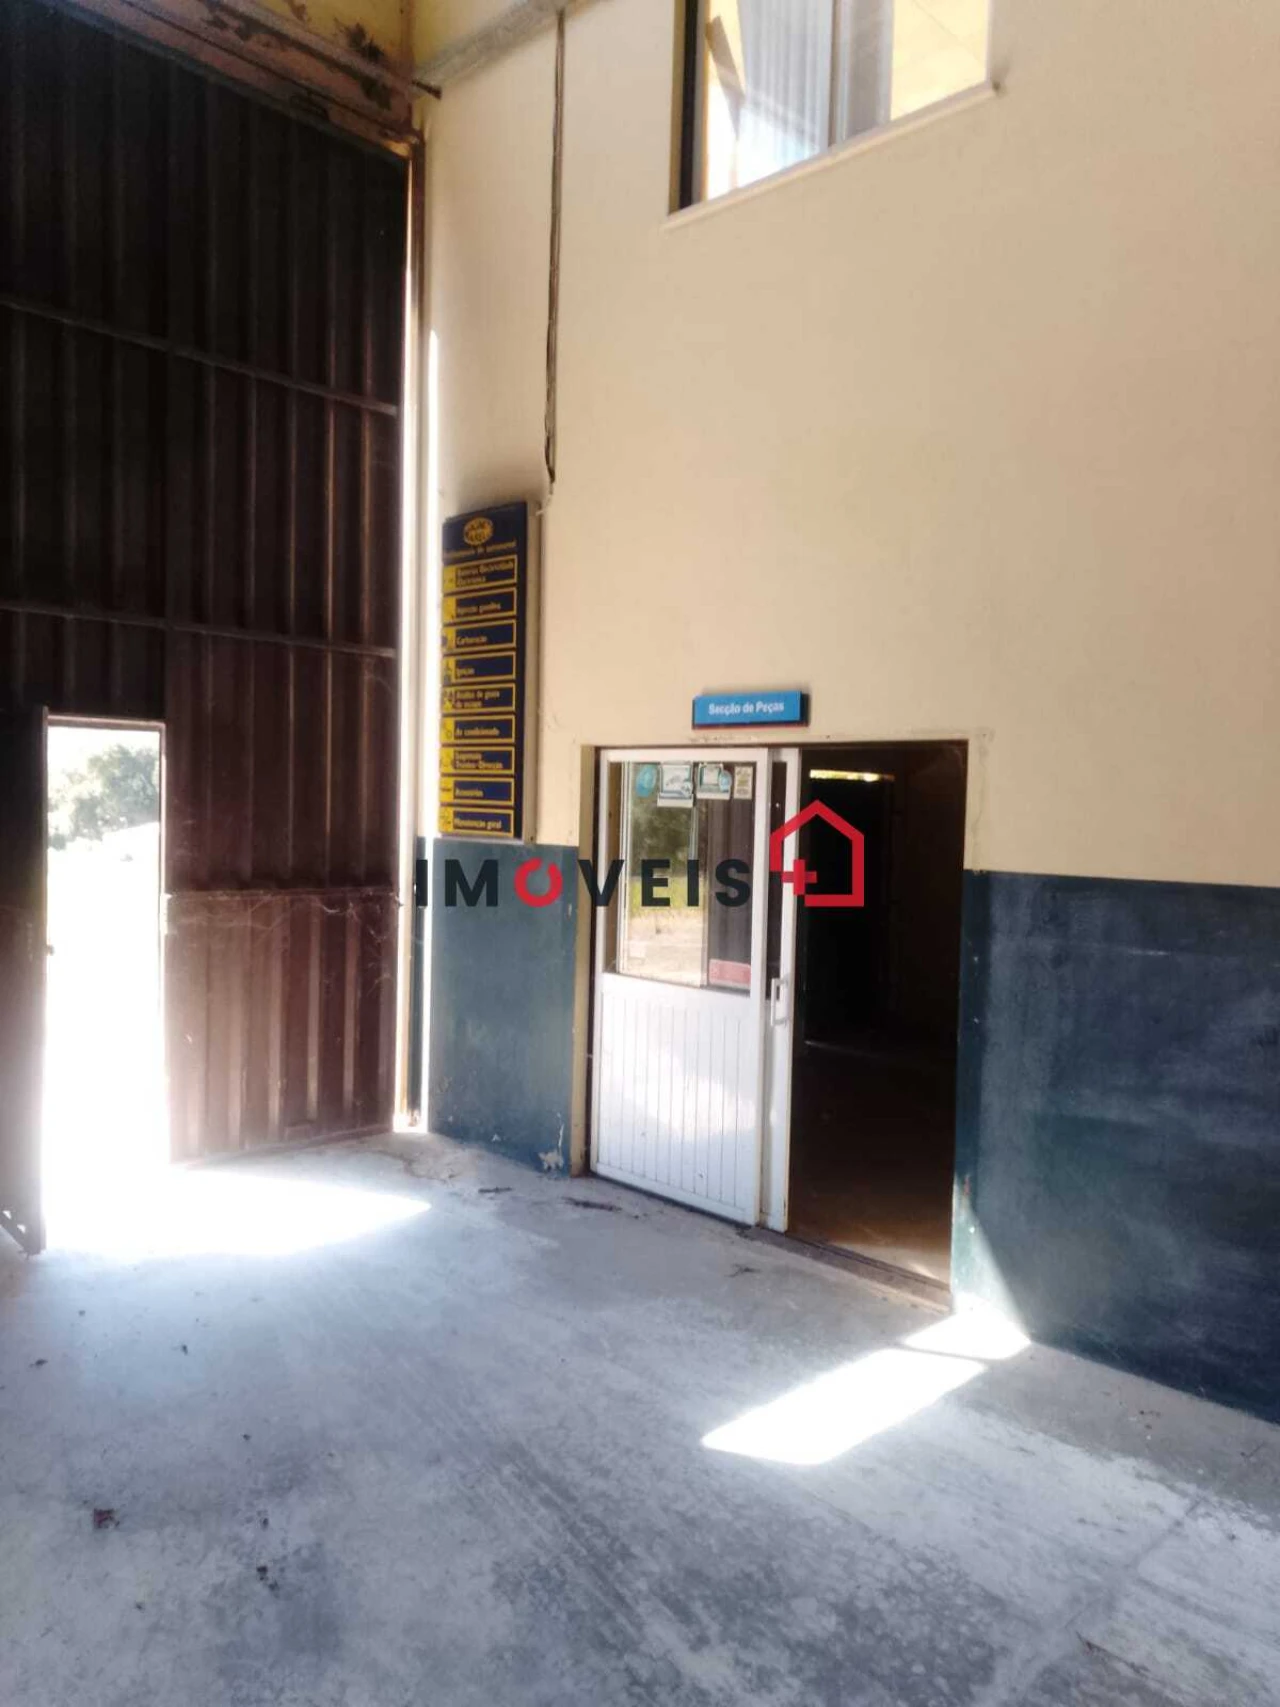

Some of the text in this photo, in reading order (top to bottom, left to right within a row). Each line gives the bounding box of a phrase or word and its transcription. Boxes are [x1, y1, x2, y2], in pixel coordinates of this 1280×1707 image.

[708, 700, 785, 716] Secção de Peças
